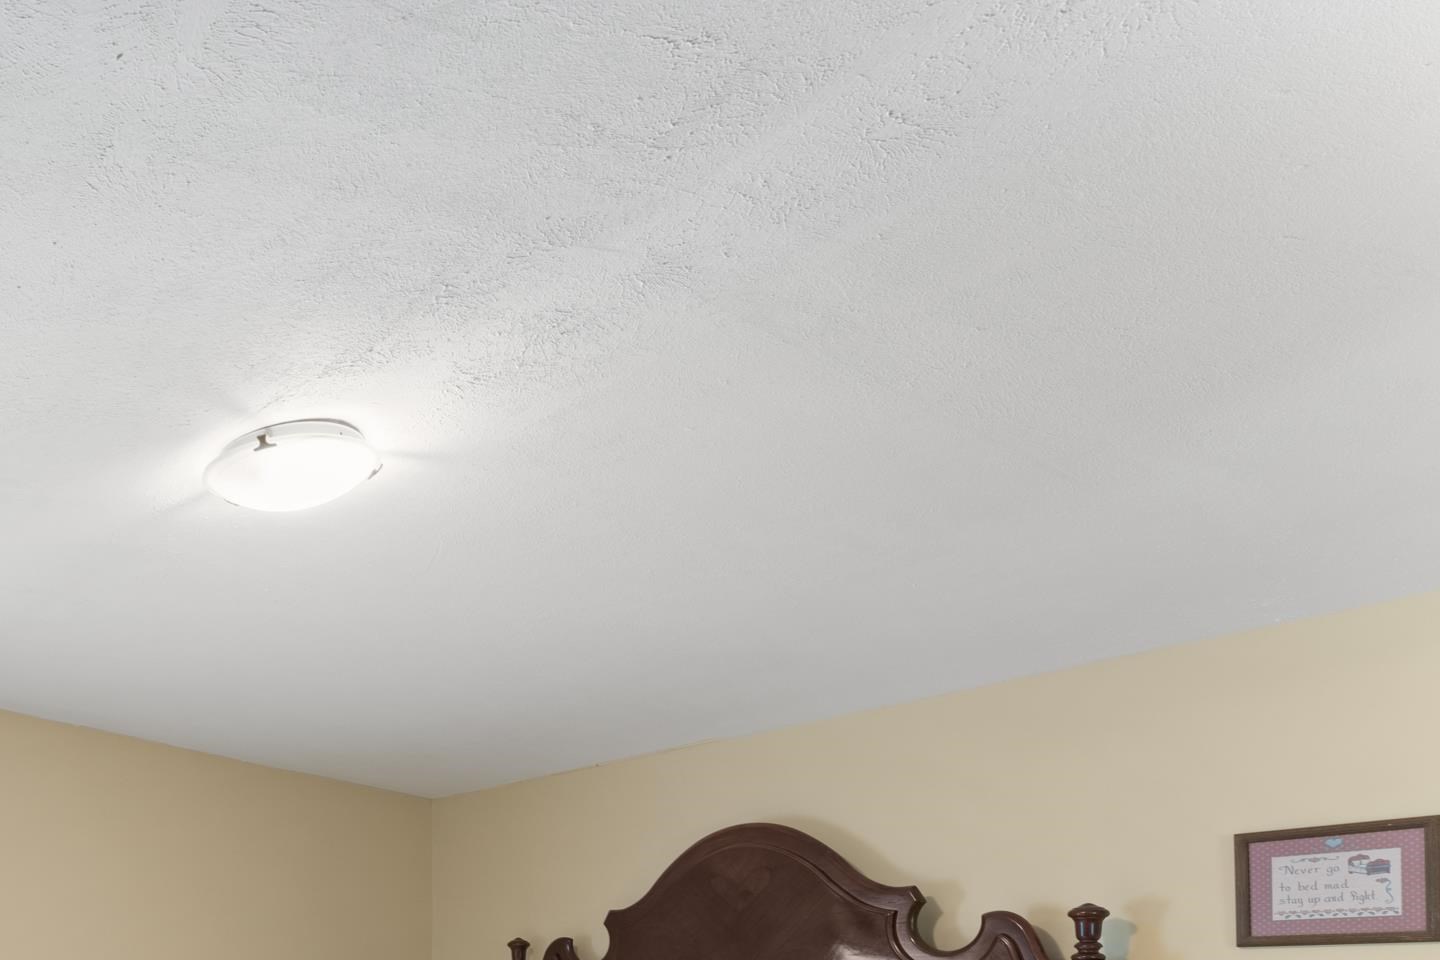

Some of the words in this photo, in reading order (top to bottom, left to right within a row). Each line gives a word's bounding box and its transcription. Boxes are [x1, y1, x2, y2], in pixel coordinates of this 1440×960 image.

[1278, 864, 1320, 876] Never
[1326, 865, 1340, 876] go
[1279, 882, 1291, 892] to
[1297, 880, 1318, 891] bed
[1324, 879, 1349, 890] mad
[1279, 895, 1304, 907] stay
[1308, 897, 1321, 905] up
[1323, 892, 1344, 903] and
[1350, 889, 1376, 904] fight
